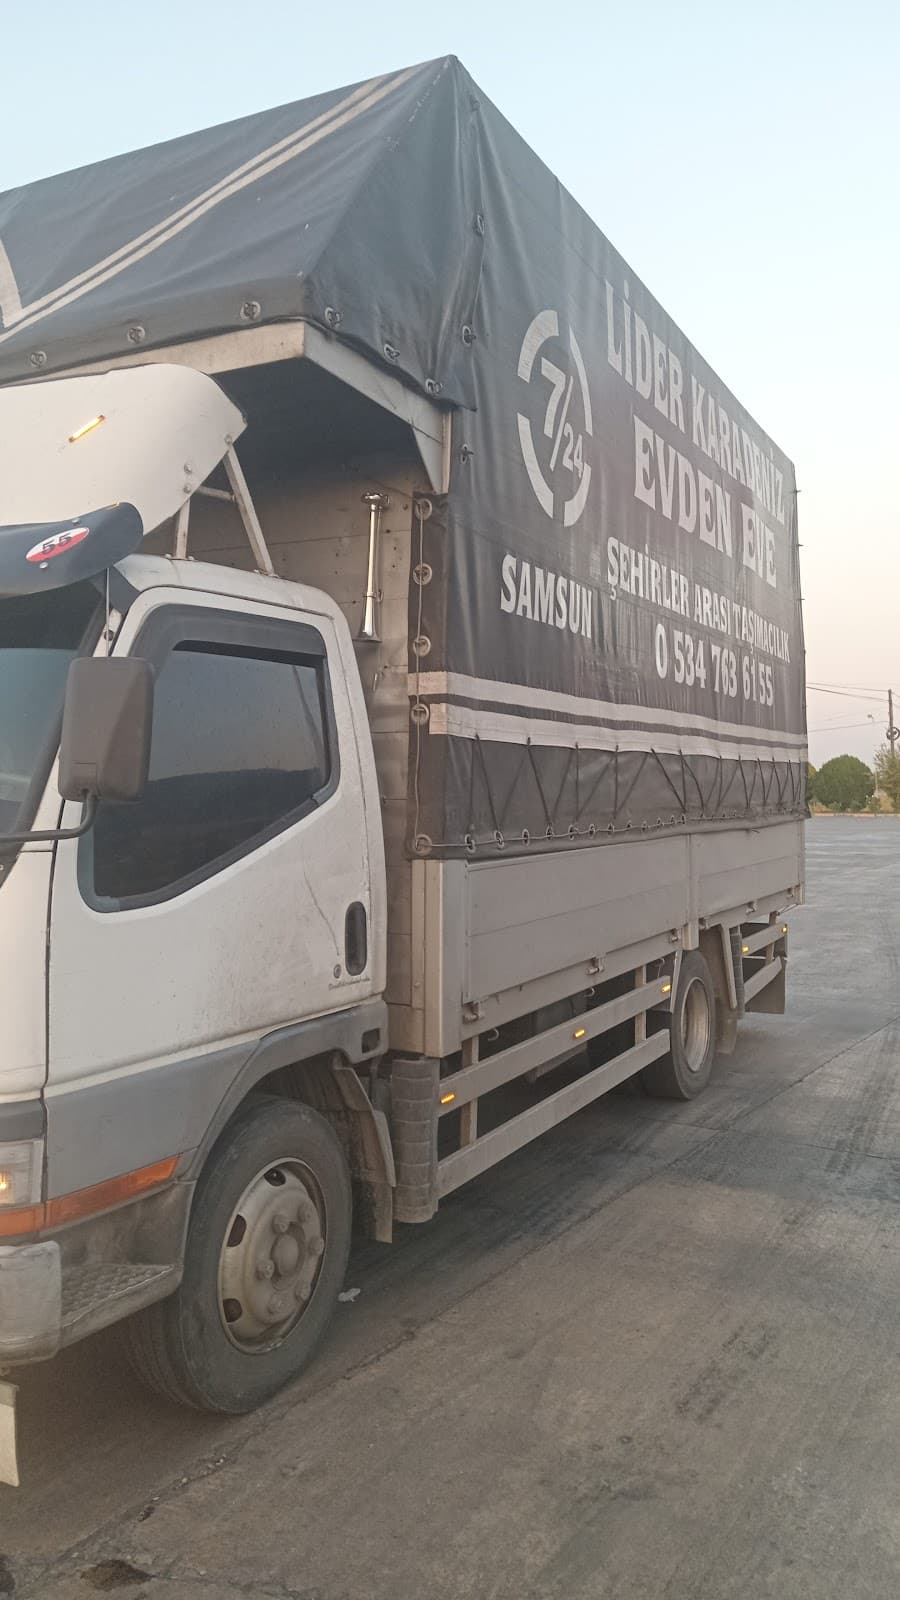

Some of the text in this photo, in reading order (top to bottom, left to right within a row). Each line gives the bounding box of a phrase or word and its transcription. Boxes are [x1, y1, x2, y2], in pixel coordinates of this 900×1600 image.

[633, 415, 777, 588] EVDEN EVE
[501, 553, 592, 639] SAMSUN
[607, 536, 690, 618] ŞEHİRLER
[694, 583, 731, 636] ARASI
[655, 623, 668, 680] 0
[674, 630, 707, 689] 534
[711, 644, 738, 698] 763
